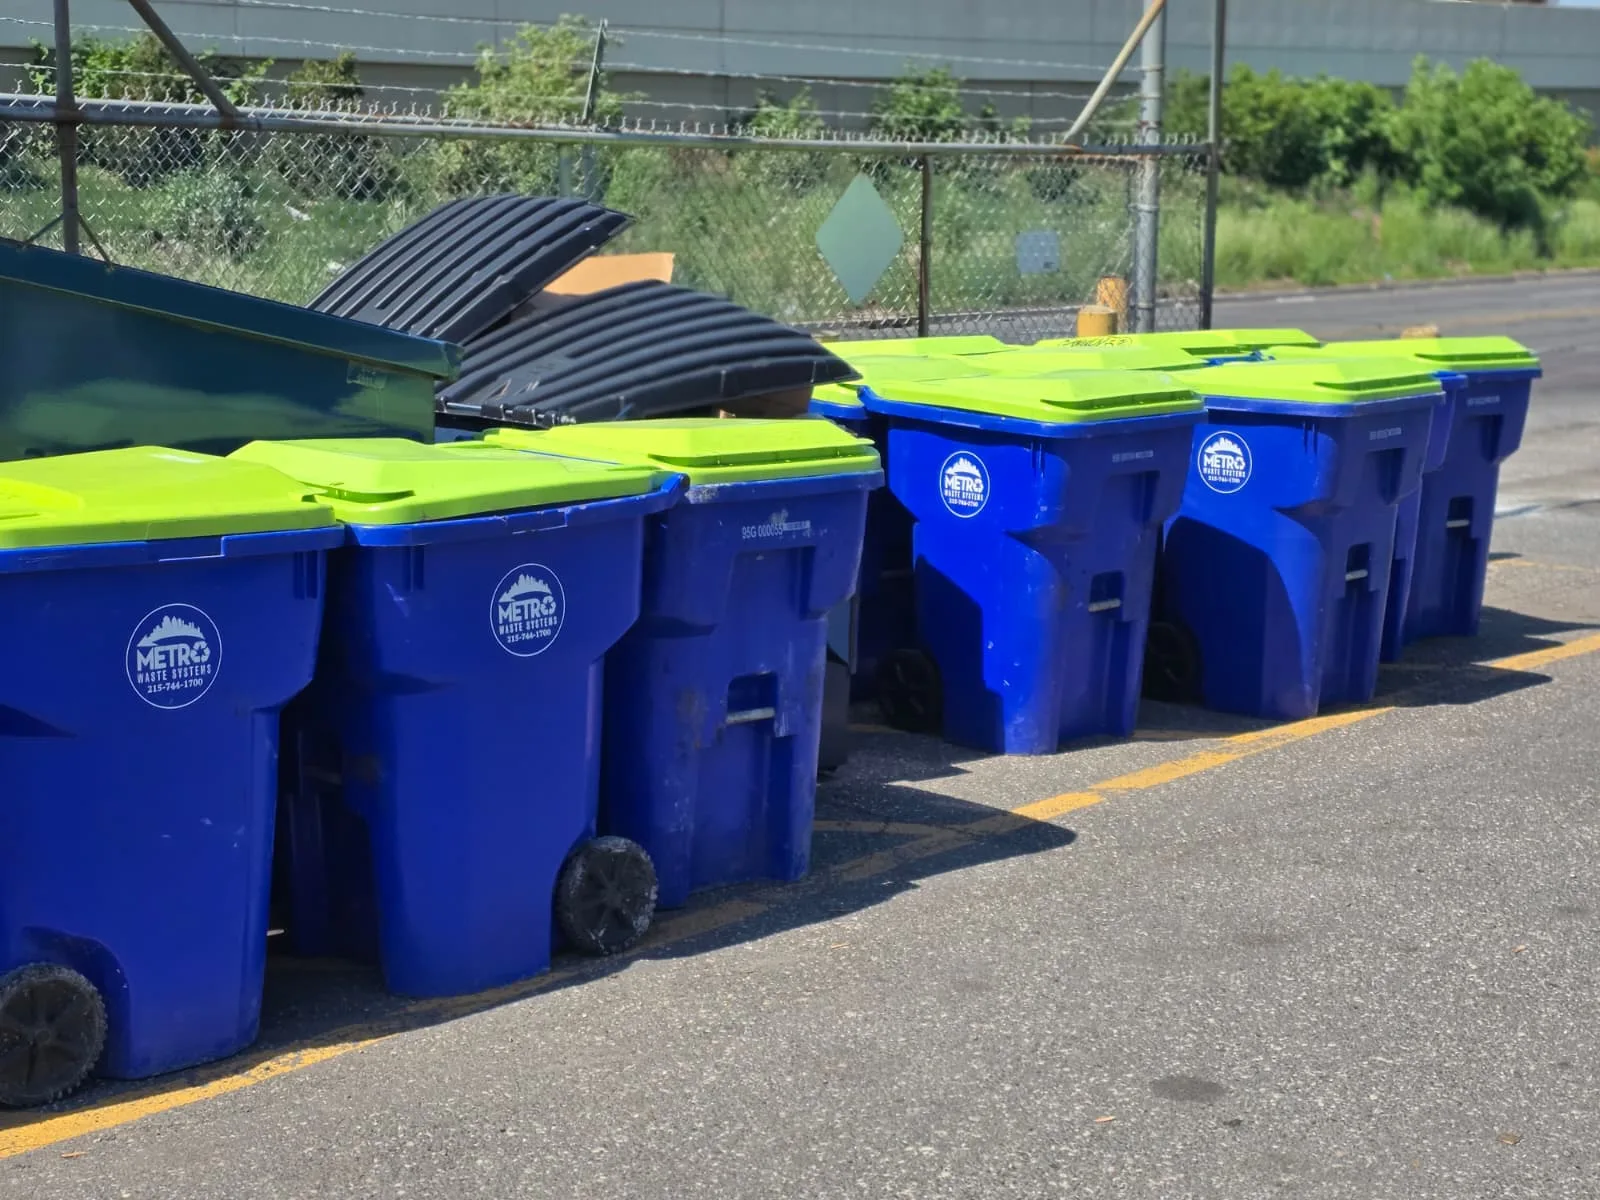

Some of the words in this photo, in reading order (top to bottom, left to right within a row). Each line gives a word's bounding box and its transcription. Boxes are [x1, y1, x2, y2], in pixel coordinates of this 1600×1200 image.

[498, 595, 557, 624] METRO
[499, 622, 523, 635] WASTE
[136, 640, 211, 671] METRO
[137, 670, 168, 684] WASTE
[172, 664, 211, 680] SYSTEMS
[147, 678, 204, 693] 215-744-1700
